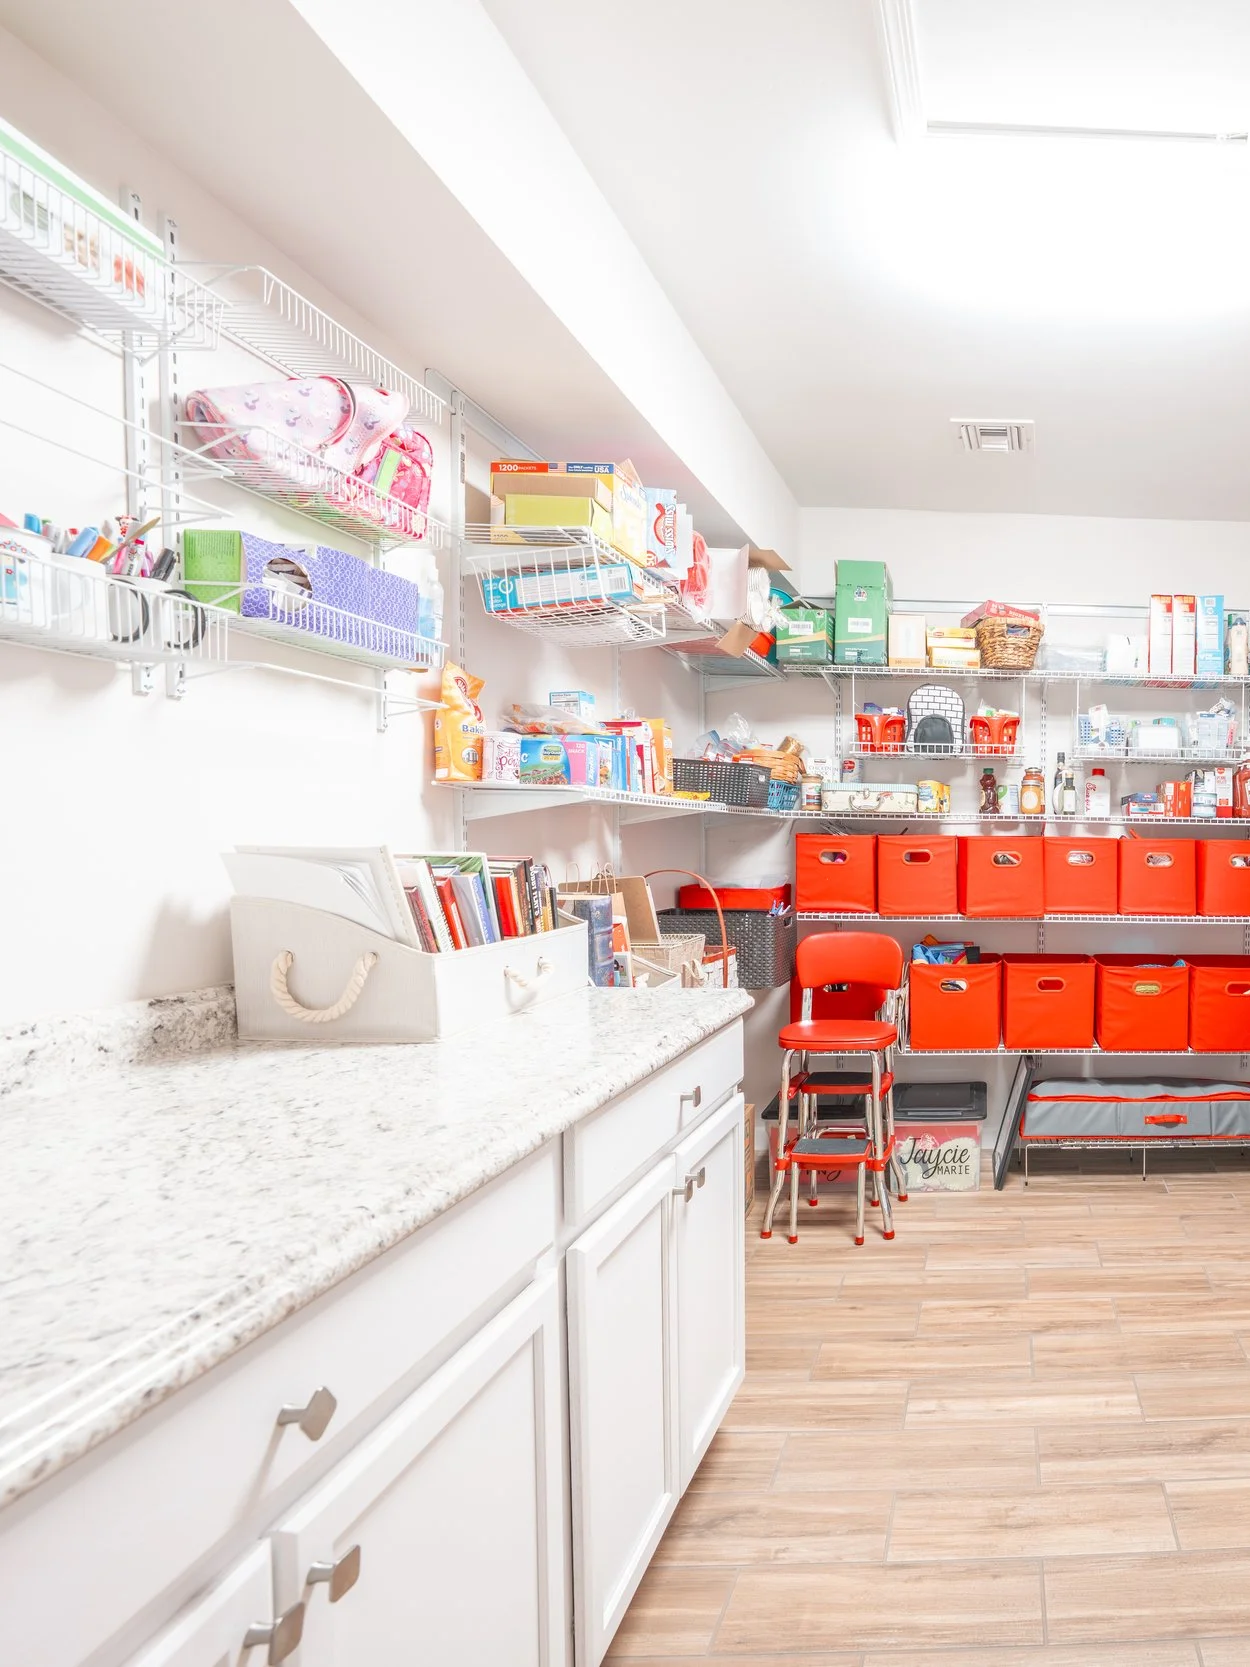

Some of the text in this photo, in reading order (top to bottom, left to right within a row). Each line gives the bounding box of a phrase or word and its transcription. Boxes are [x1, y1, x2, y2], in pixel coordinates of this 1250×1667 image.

[499, 464, 519, 472] 1200
[664, 503, 676, 554] SWISS MISS
[462, 724, 485, 734] Bak
[900, 1137, 970, 1179] Jaycie
[937, 1165, 970, 1175] MARIE
